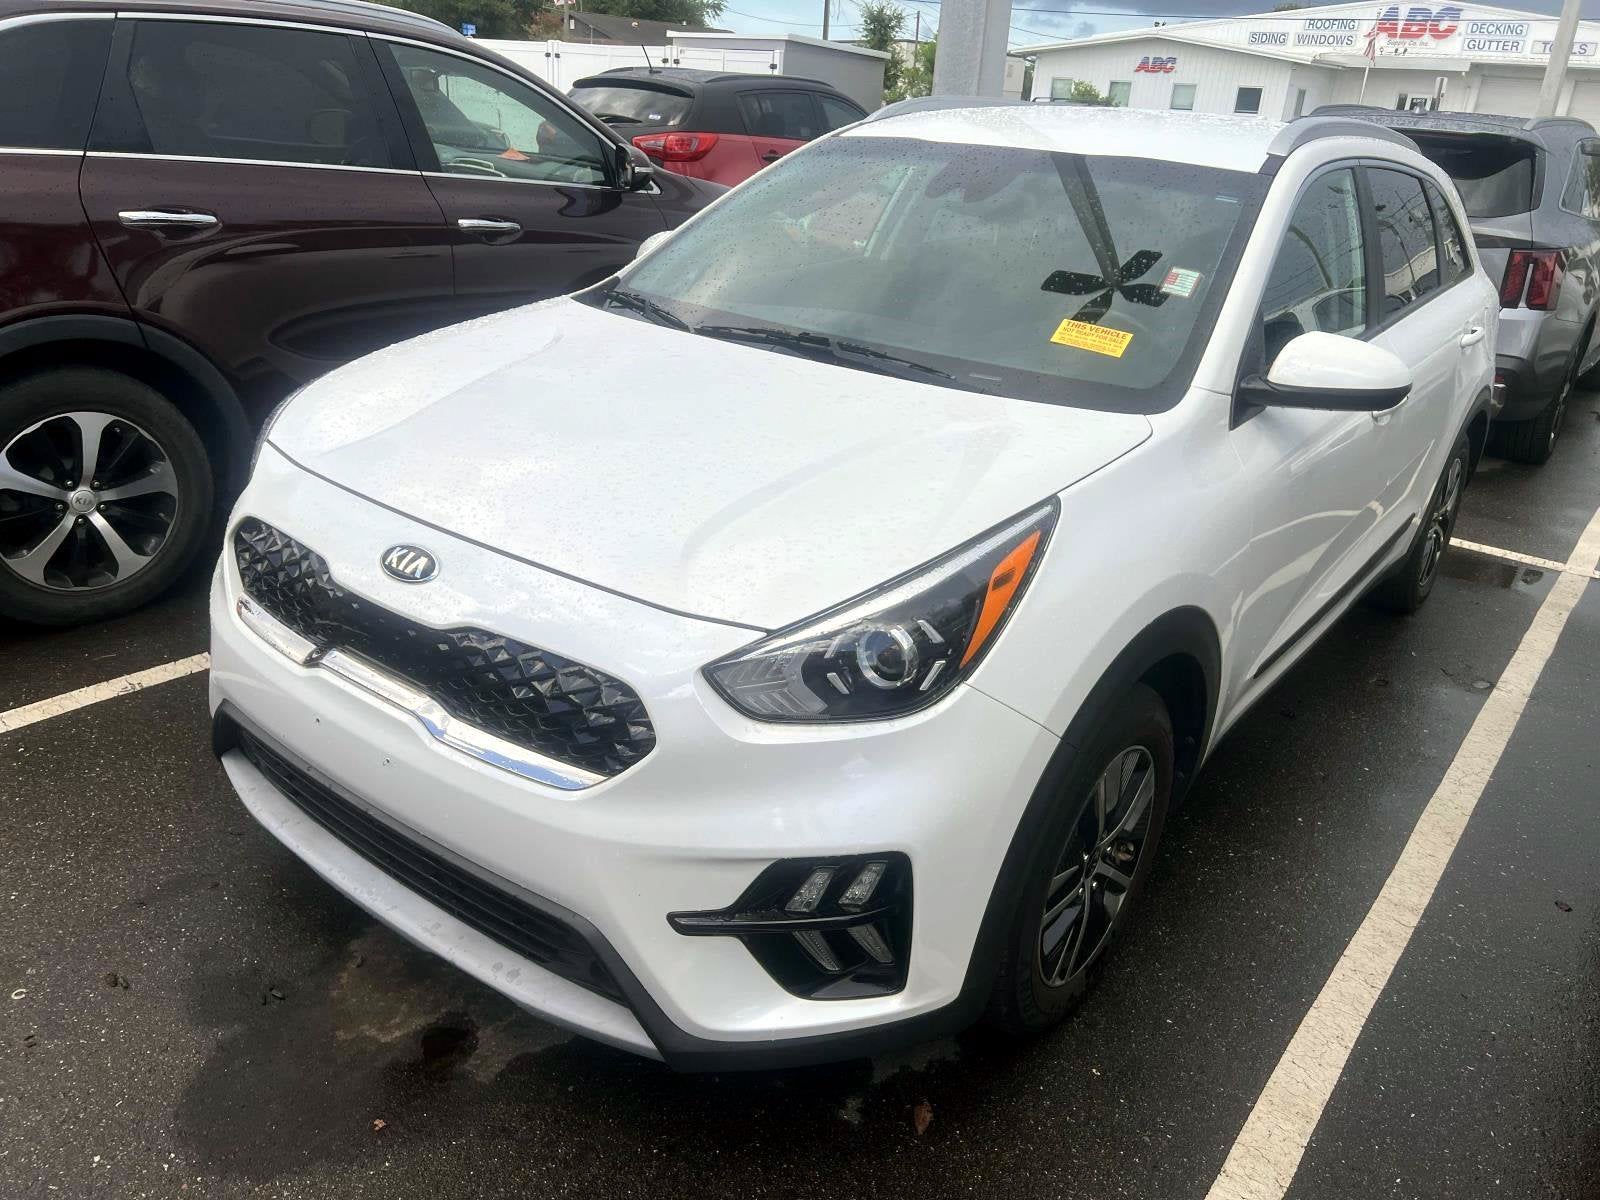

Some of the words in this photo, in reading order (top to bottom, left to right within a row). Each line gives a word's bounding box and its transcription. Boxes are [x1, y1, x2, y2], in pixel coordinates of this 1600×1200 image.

[1307, 19, 1356, 30] ROOFING
[1376, 6, 1464, 40] ABC
[1470, 23, 1524, 35] DECKING
[1250, 33, 1287, 44] SIDING
[1297, 34, 1354, 46] WINDOWS
[1387, 39, 1406, 47] Supply
[1467, 39, 1520, 52] GUTTER
[1134, 56, 1177, 74] ABC
[1066, 321, 1087, 330] THIS
[1089, 326, 1128, 340] VEHICLE
[1096, 333, 1108, 341] FOR
[384, 546, 429, 578] KIA
